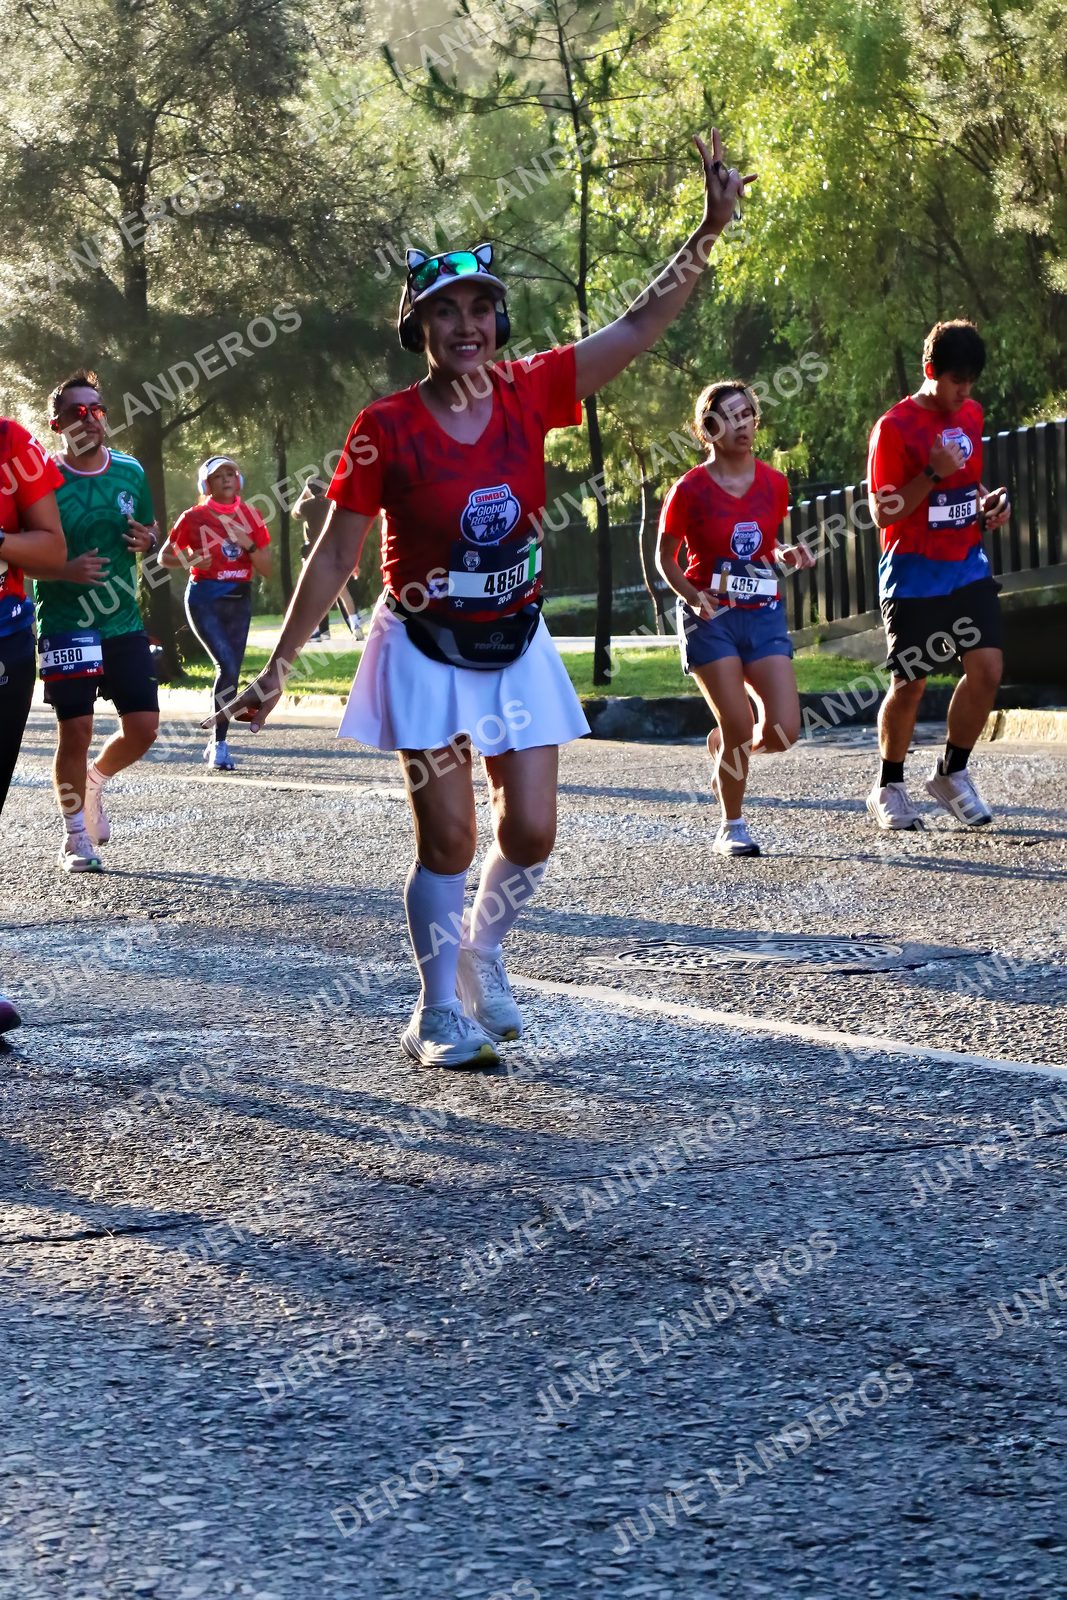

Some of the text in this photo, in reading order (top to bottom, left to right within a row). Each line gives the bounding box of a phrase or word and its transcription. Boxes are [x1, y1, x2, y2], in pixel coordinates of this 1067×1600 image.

[475, 491, 506, 504] BIMBO
[477, 502, 507, 517] Global
[948, 502, 972, 519] 4856
[470, 514, 496, 526] Race
[484, 563, 525, 595] 4850
[731, 577, 760, 593] 4857
[474, 642, 515, 651] TOPTIME
[53, 648, 83, 665] 5580
